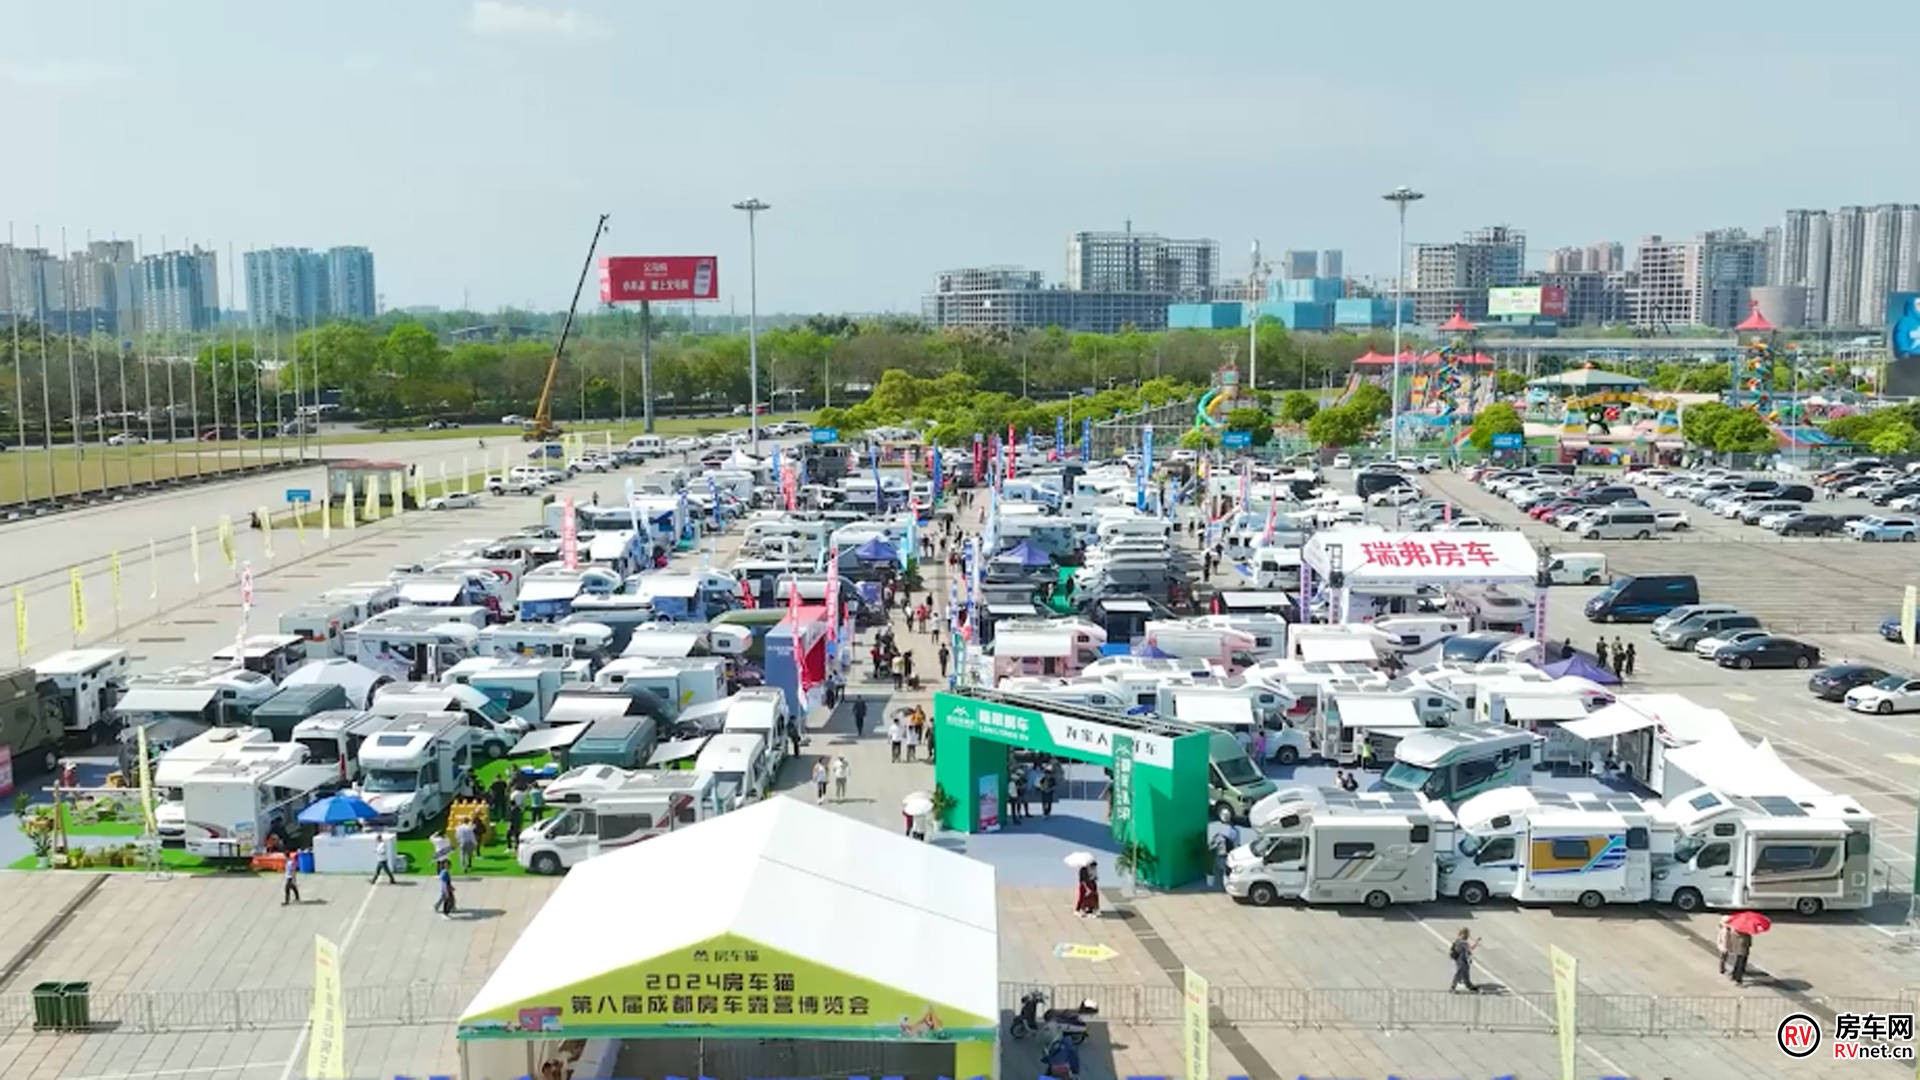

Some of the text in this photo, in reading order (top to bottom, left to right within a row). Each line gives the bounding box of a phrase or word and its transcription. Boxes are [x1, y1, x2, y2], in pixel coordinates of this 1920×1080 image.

[1361, 540, 1499, 567] 瑞弗房车
[646, 973, 795, 991] 2024房车猫
[571, 995, 870, 1015] 第八届成都房车露营博览会
